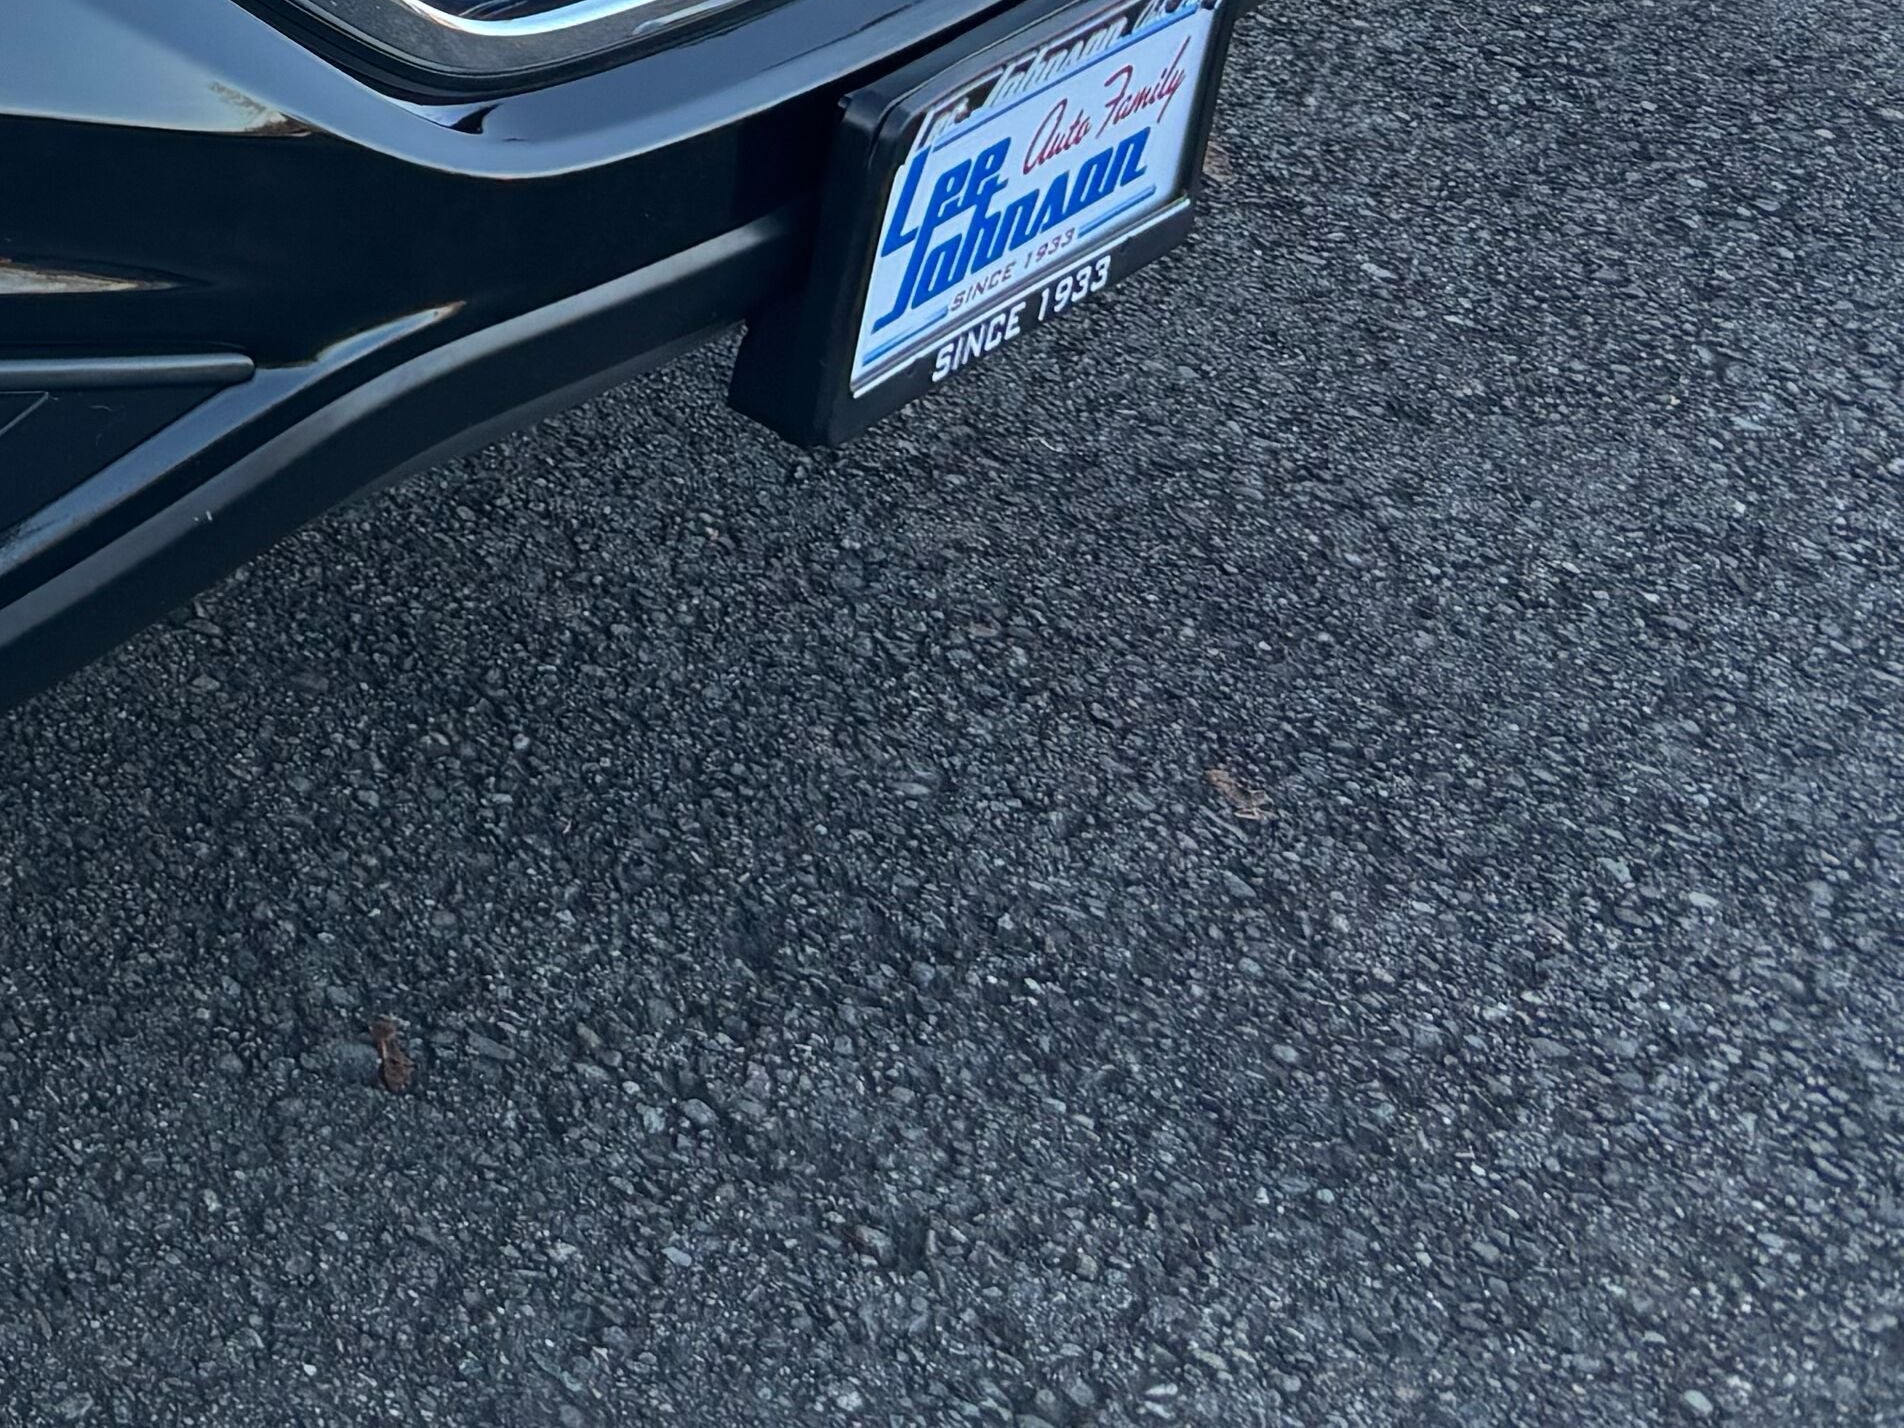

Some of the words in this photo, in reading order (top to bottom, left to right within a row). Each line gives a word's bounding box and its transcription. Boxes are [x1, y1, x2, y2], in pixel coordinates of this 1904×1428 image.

[1023, 98, 1091, 175] Auto
[1095, 35, 1190, 139] Family
[871, 126, 1151, 334] Johnson
[881, 137, 1012, 258] Lee
[932, 301, 1026, 383] SINCE
[1037, 255, 1111, 321] 1933
[948, 261, 1016, 311] SINCE
[1023, 227, 1076, 270] 1933
